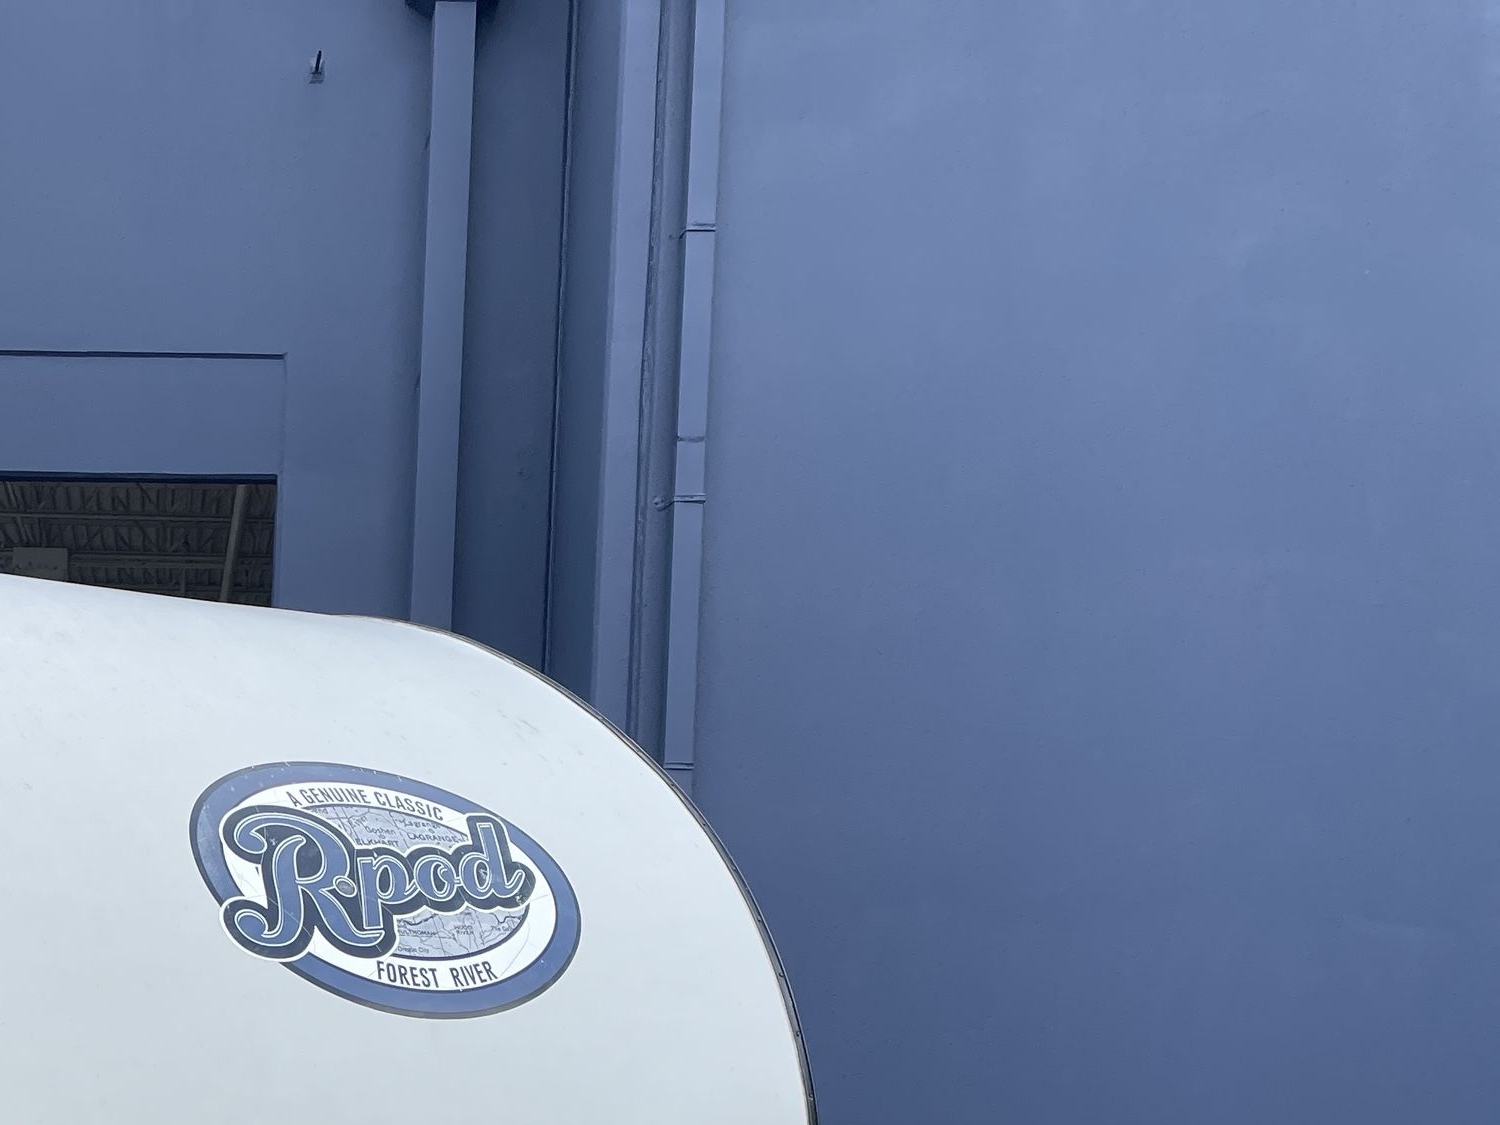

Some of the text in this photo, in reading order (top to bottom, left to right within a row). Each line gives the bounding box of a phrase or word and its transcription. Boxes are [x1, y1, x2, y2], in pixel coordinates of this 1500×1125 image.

[286, 787, 444, 821] A GENUINE CLASSIC
[376, 960, 499, 988] FOREST RIVER
